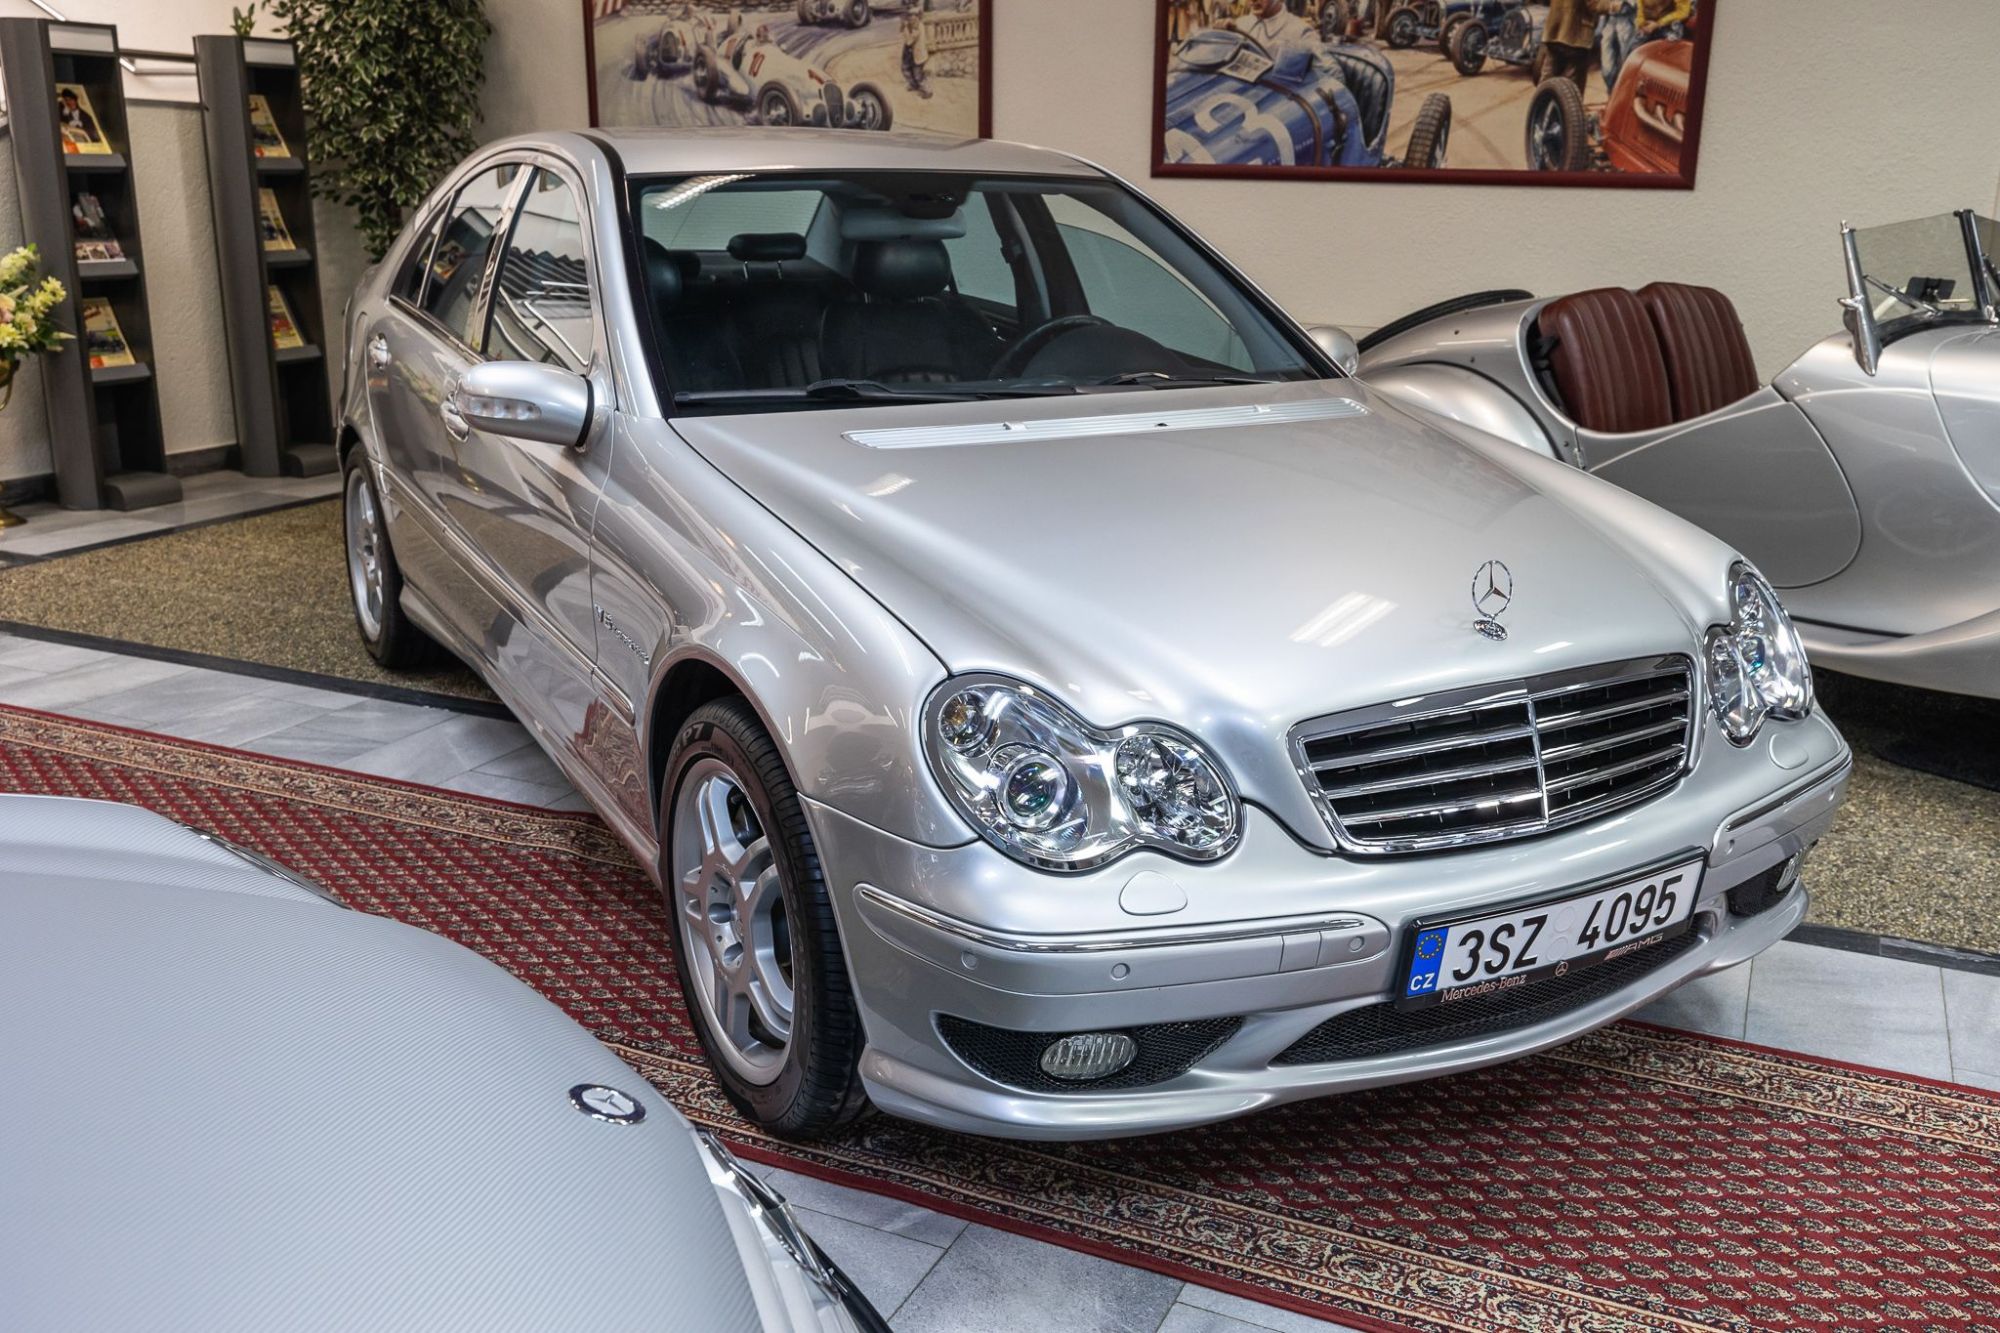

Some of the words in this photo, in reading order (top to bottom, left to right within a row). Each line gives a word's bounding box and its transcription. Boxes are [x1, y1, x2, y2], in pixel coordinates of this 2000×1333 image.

[1452, 914, 1549, 982] 3SZ
[1577, 873, 1684, 950] 4095
[1410, 972, 1435, 991] CZ
[1440, 974, 1527, 1003] Mercedes-Benz
